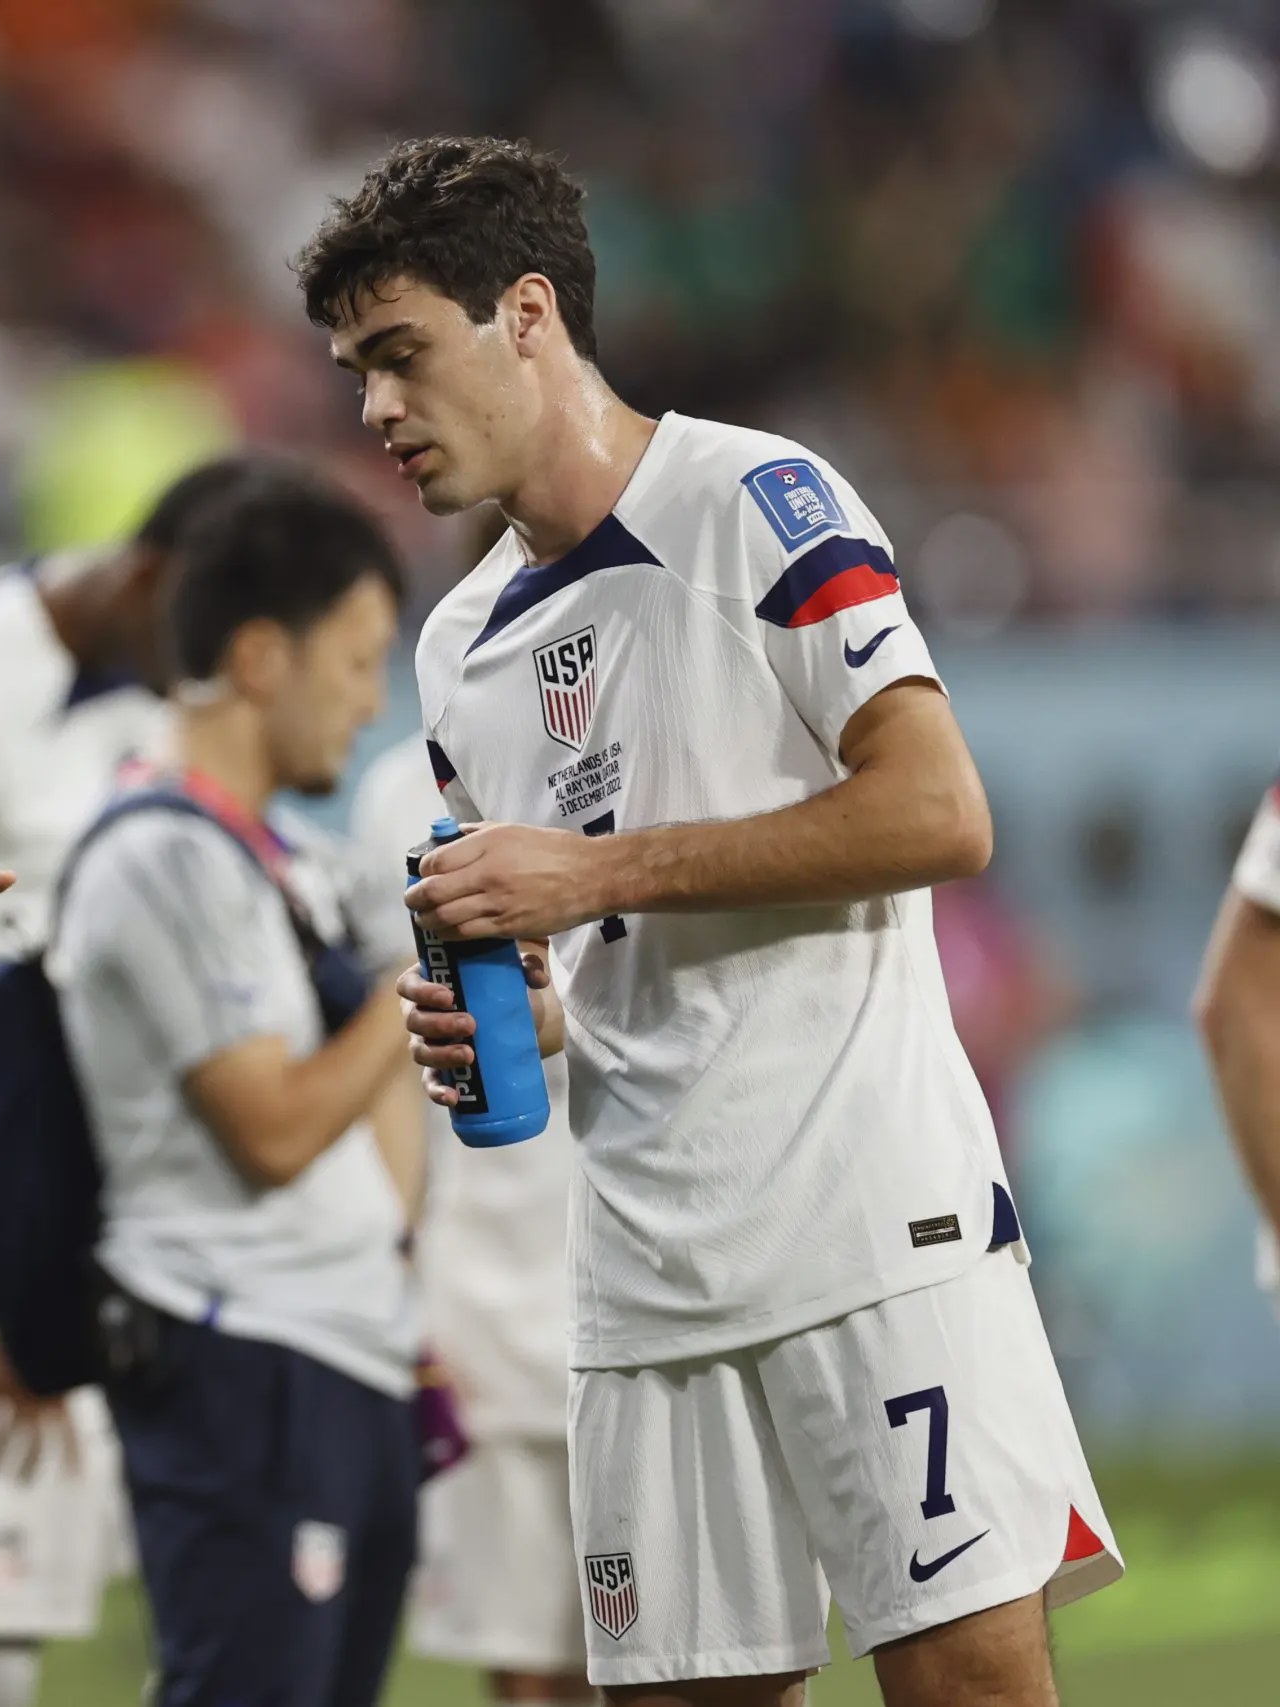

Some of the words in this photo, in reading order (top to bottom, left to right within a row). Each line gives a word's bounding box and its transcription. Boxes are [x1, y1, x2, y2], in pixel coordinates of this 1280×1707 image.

[539, 633, 594, 687] USA
[547, 753, 603, 790] NETHERLANDS
[609, 741, 622, 759] USA
[555, 786, 566, 801] AL
[558, 803, 567, 817] 3
[566, 785, 606, 814] DECEMBER
[606, 776, 622, 796] 2022
[883, 1385, 956, 1520] 7
[590, 1557, 630, 1590] USA
